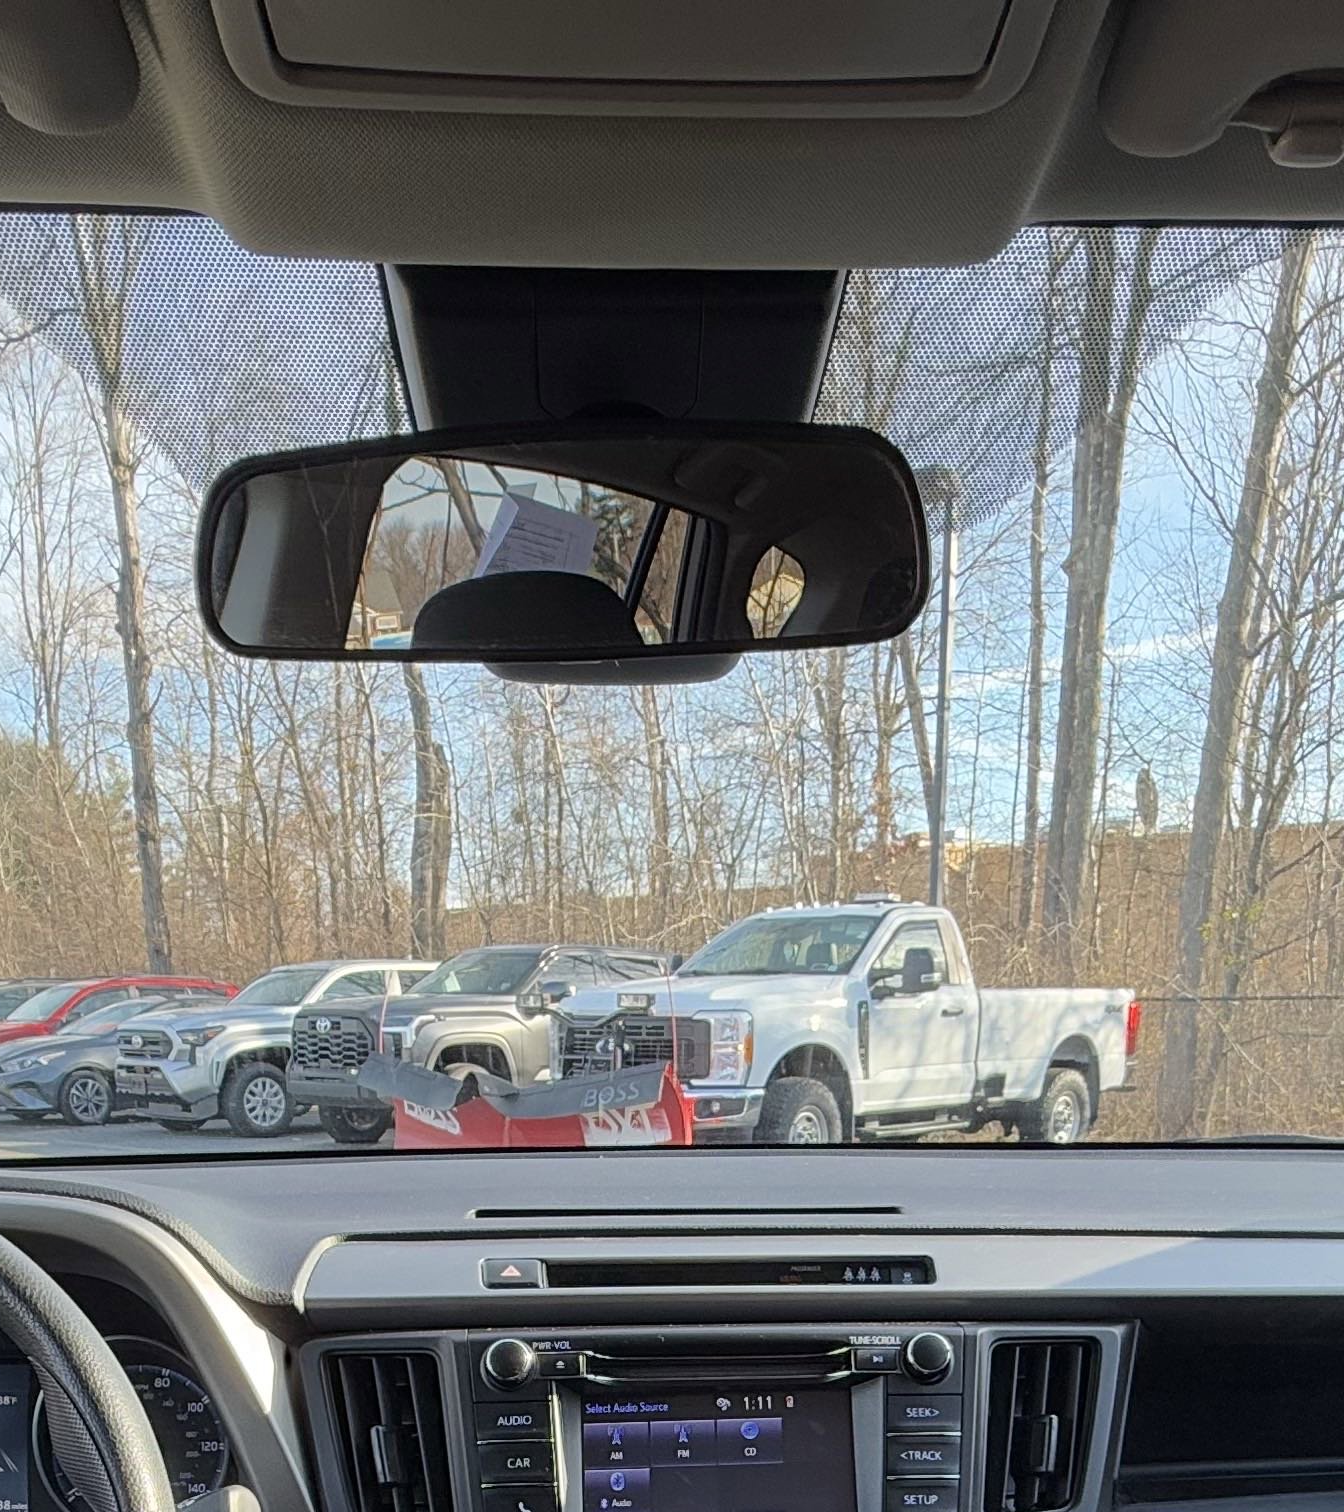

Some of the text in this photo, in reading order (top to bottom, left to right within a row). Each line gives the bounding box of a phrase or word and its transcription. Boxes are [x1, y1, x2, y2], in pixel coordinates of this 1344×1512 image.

[584, 1081, 640, 1108] BOSS
[154, 1377, 171, 1388] 80
[187, 1402, 204, 1412] 100
[585, 1402, 670, 1414] Select Audio Source
[743, 1395, 772, 1411] 1:11
[496, 1415, 533, 1426] AUDIO
[201, 1441, 218, 1452] 120
[610, 1447, 757, 1461] AM FM CD
[507, 1457, 531, 1469] CAR
[188, 1483, 206, 1495] 140
[612, 1498, 633, 1508] Audio
[903, 1494, 939, 1505] SETUP
